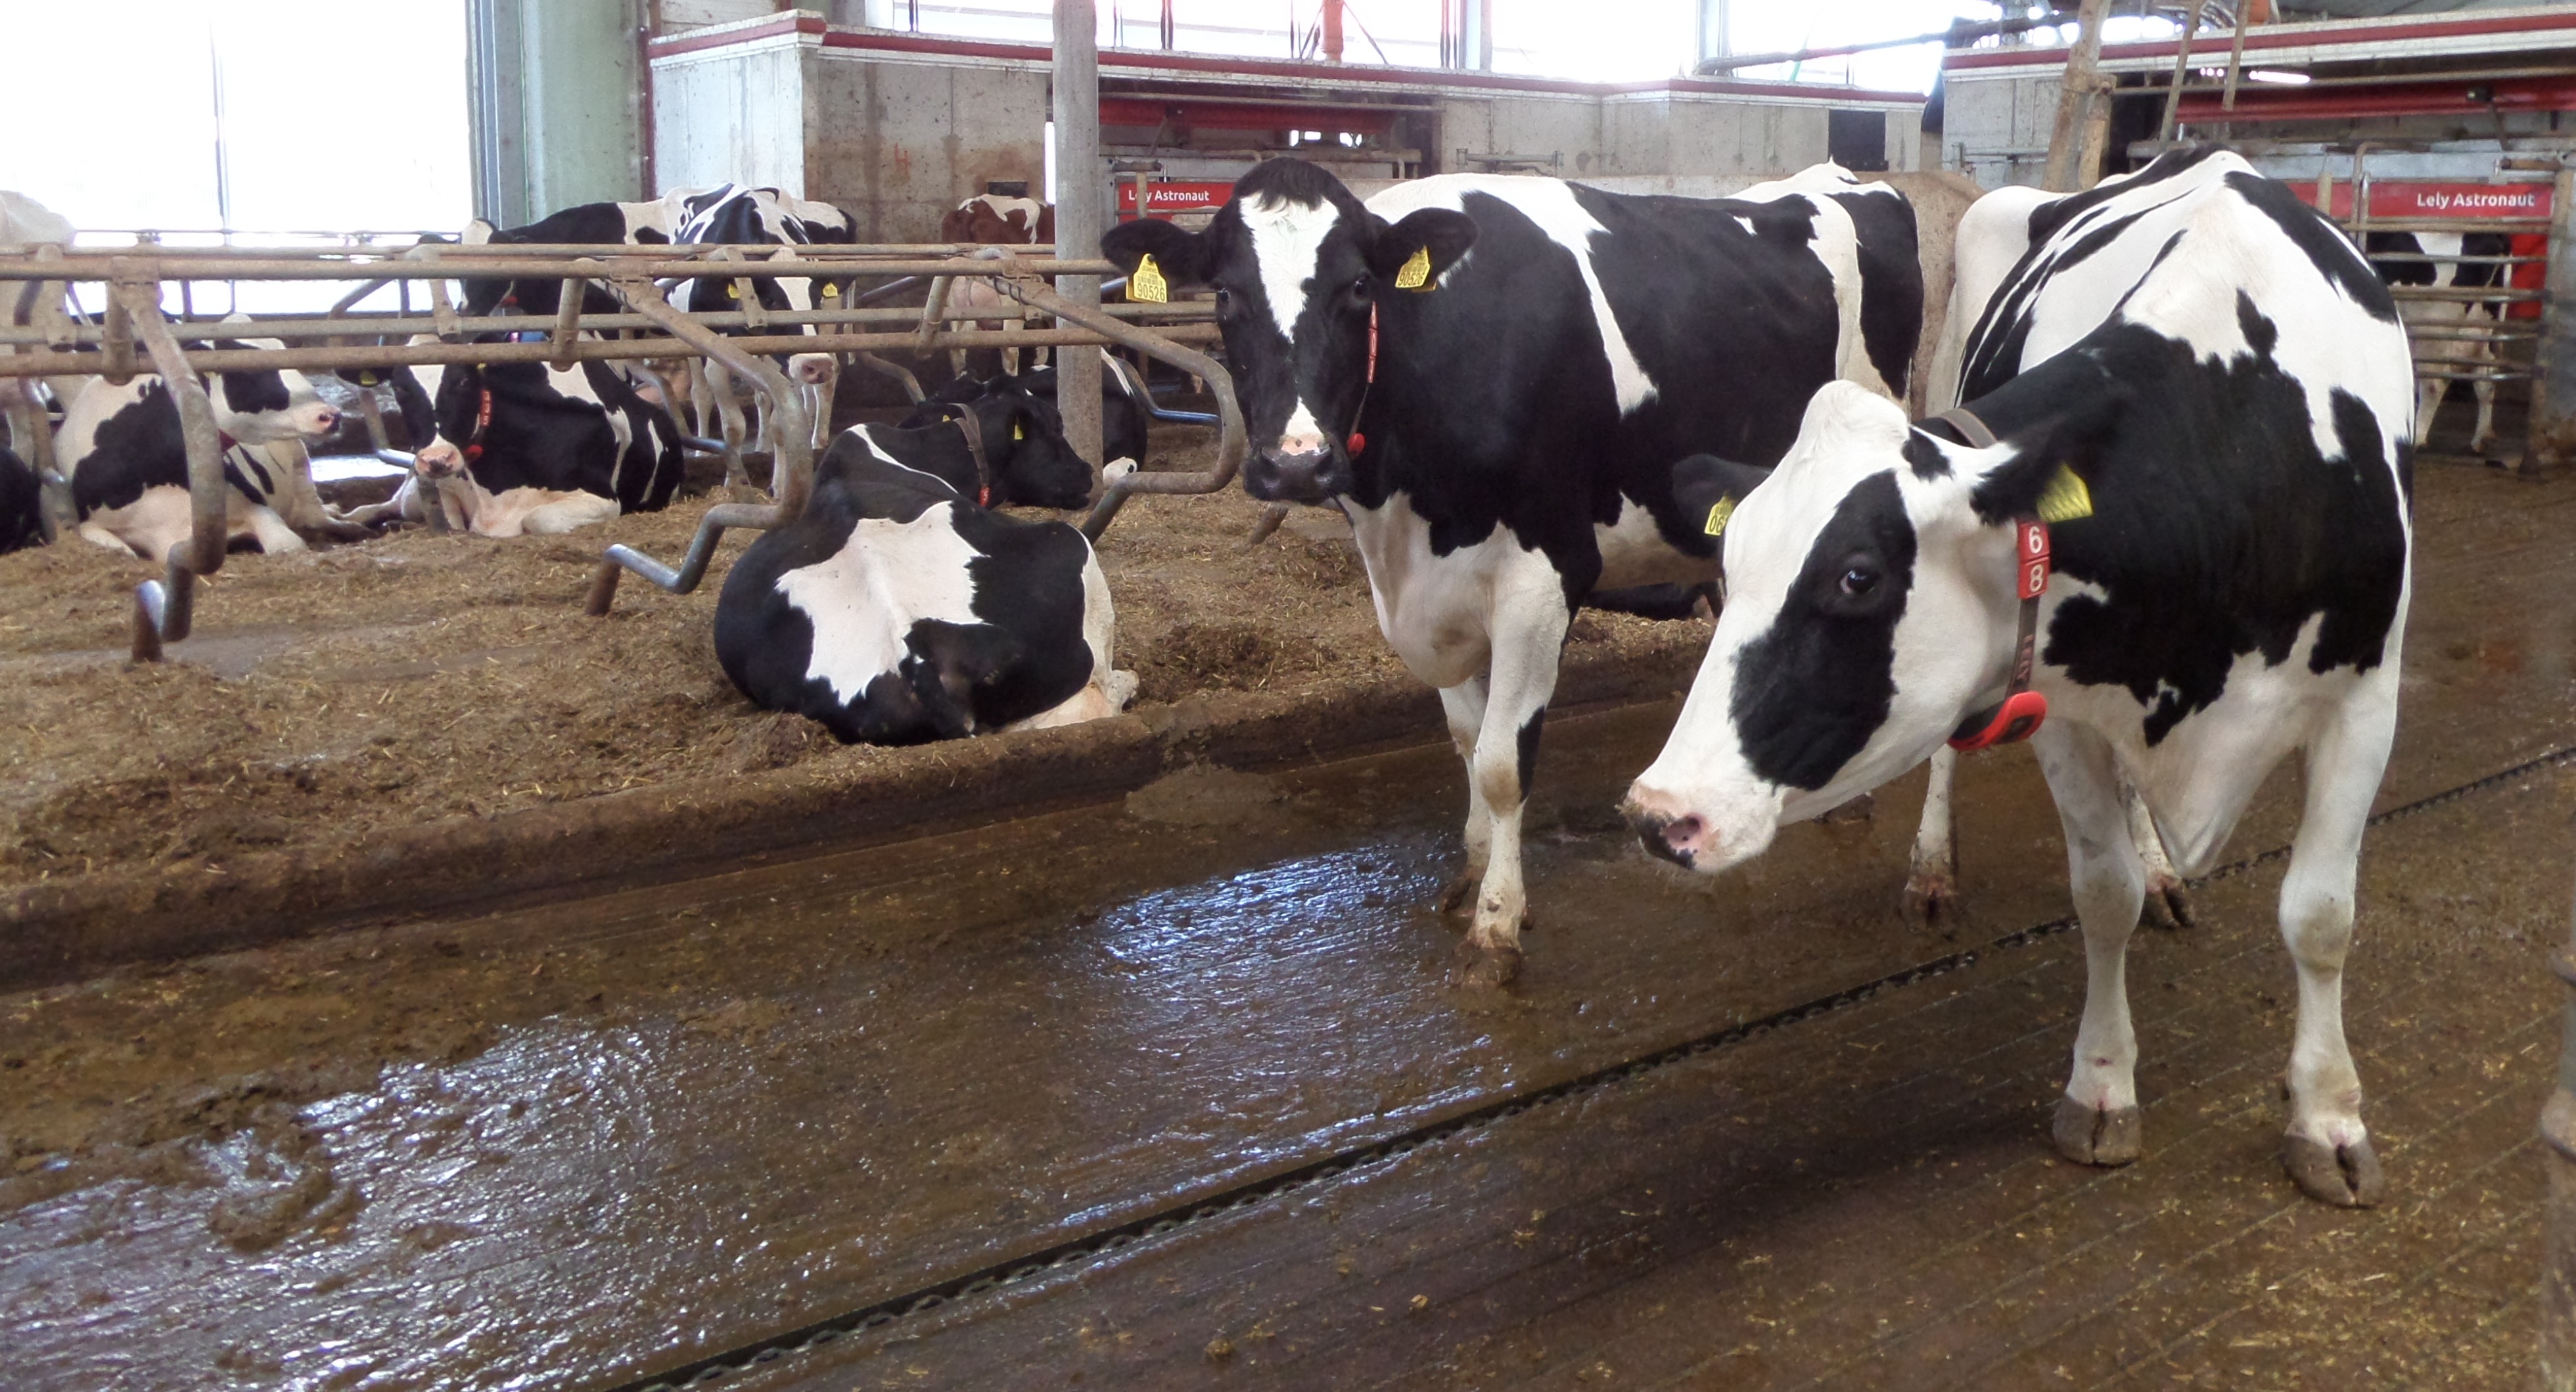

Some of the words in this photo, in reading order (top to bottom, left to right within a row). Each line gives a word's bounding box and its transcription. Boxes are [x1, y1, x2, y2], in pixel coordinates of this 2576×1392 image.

[1128, 190, 1152, 202] Ly
[1155, 190, 1210, 201] Astronaut
[2417, 191, 2449, 210] Lely
[2452, 192, 2535, 207] Astronaut
[1137, 282, 1165, 302] 90526
[1709, 514, 1728, 533] 06
[2029, 526, 2043, 554] 6
[2029, 564, 2044, 592] 8
